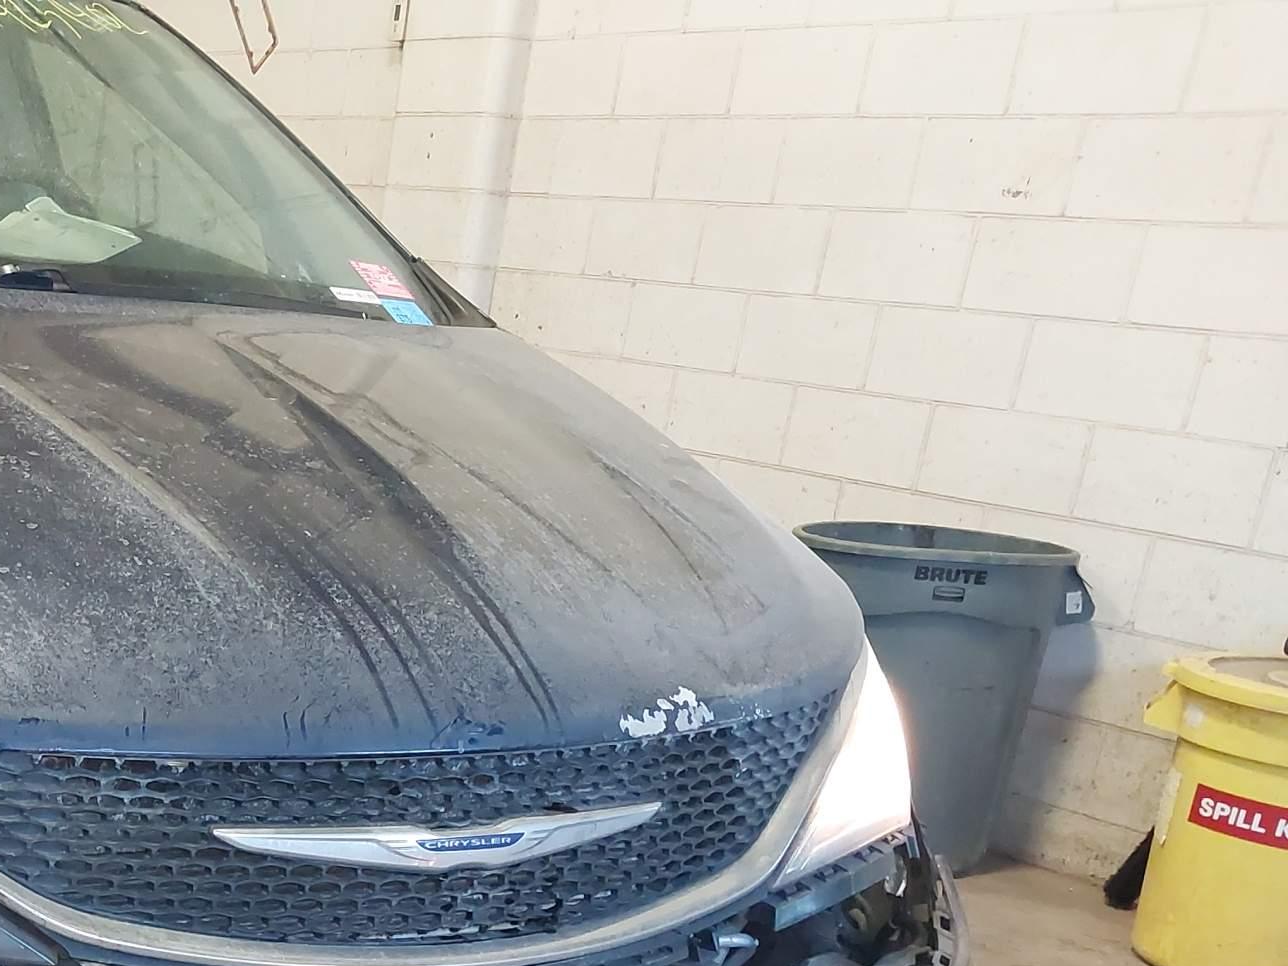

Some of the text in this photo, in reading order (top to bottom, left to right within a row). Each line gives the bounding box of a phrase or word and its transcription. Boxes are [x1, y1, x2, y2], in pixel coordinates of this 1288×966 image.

[914, 566, 987, 585] BRUTE
[1199, 797, 1266, 834] SPILL
[425, 837, 511, 849] CHRYSLER
